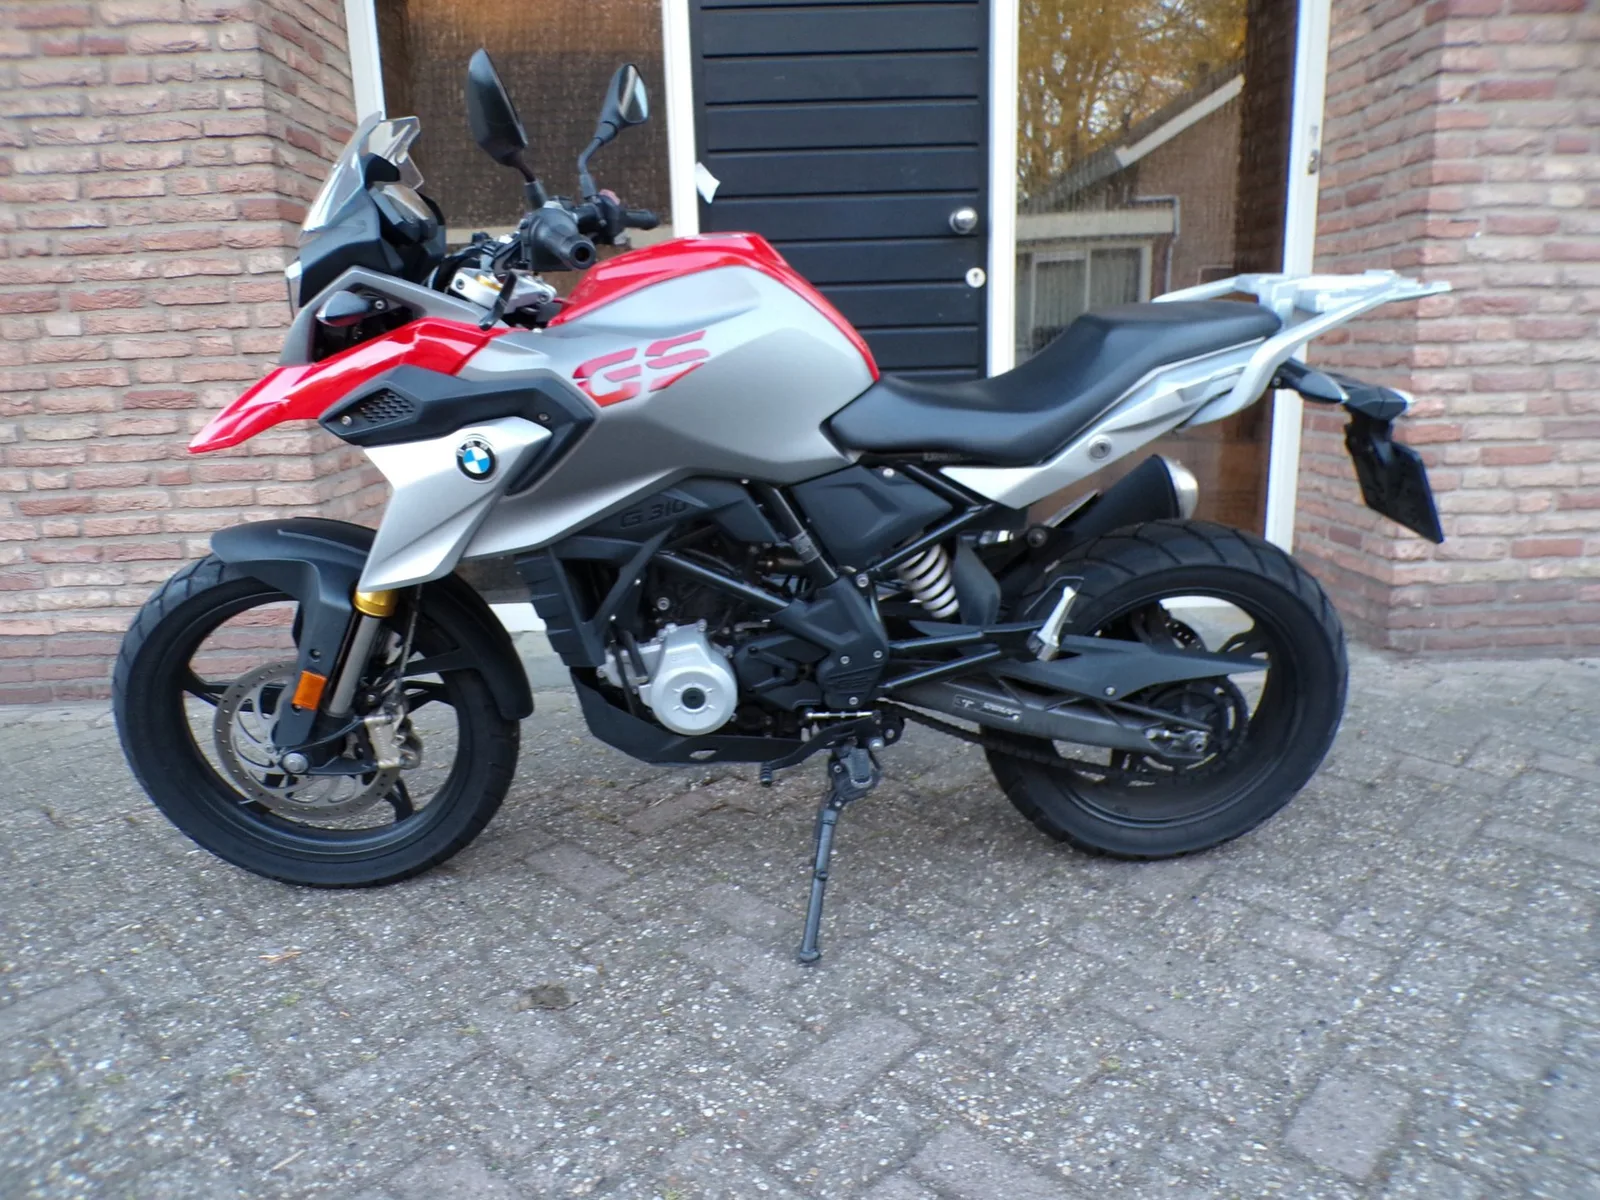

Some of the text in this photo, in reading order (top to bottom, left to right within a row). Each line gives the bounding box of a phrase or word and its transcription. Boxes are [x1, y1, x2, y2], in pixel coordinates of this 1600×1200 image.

[572, 330, 710, 408] GS
[621, 500, 687, 528] G 310
